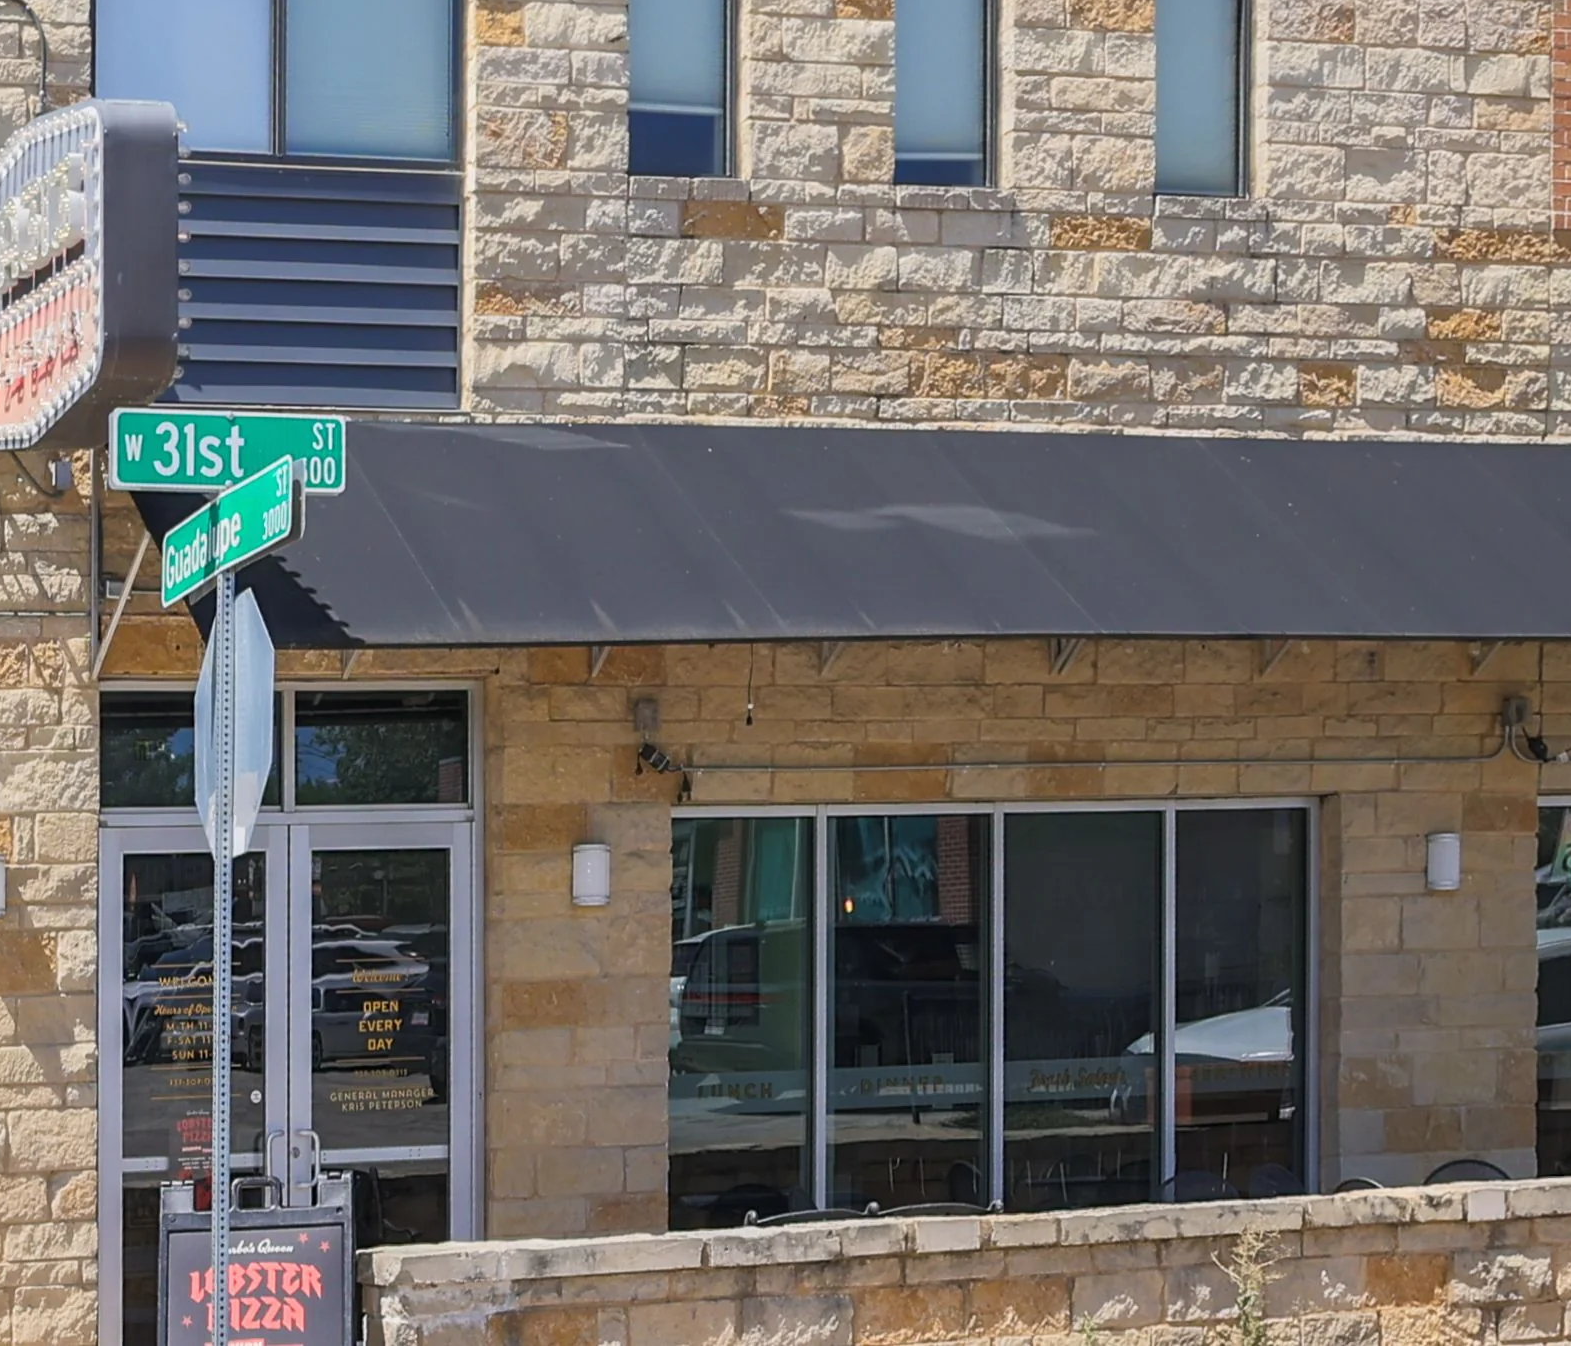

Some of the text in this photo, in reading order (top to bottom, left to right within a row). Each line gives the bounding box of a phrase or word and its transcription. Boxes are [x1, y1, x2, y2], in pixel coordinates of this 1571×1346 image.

[125, 421, 336, 478] W 31st ST
[275, 465, 290, 498] ST
[303, 456, 336, 485] 00
[262, 500, 288, 541] 3000
[165, 511, 242, 590] Guadalupe
[363, 999, 400, 1013] OPEN
[358, 1019, 403, 1033] EVERY
[367, 1038, 394, 1051] DAY
[329, 1087, 435, 1102] GENERAL MANAGER
[341, 1098, 423, 1112] KRIS PETERSON
